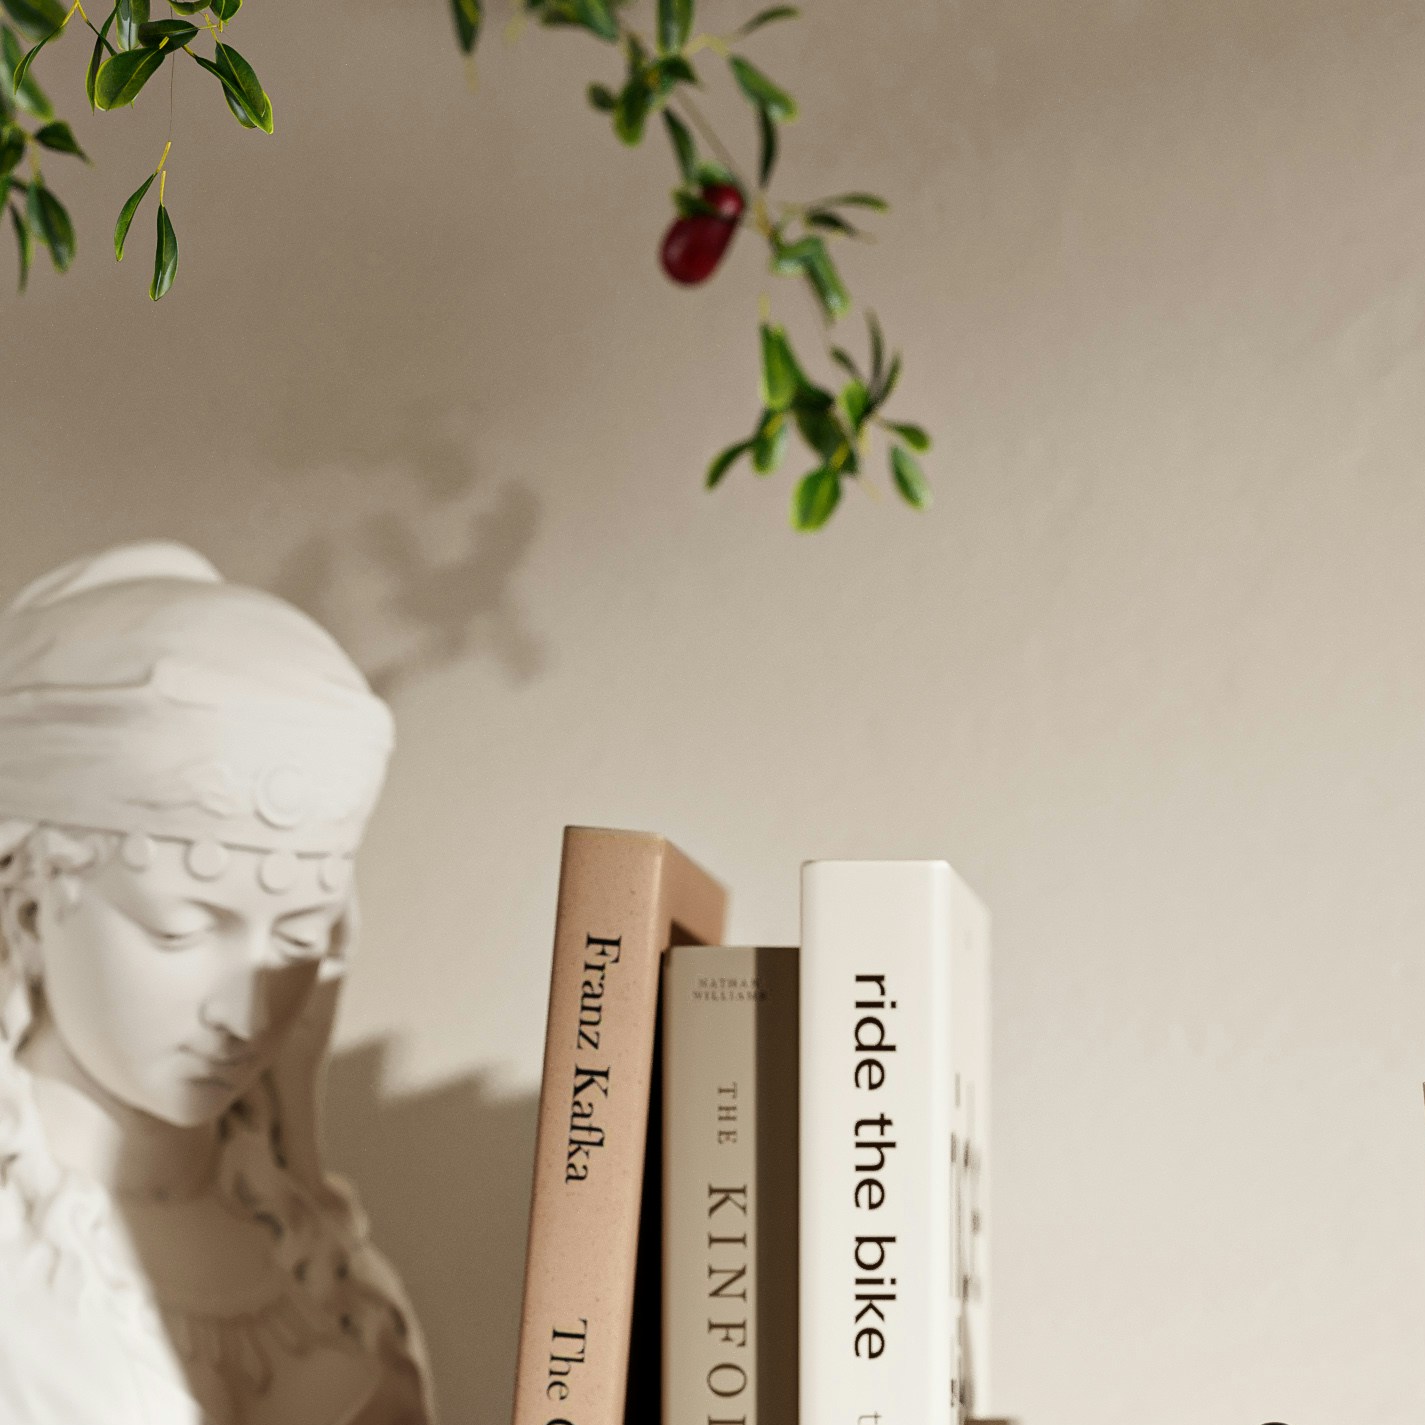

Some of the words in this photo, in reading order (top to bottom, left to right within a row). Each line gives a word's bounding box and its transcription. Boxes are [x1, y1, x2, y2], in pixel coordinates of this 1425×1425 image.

[577, 934, 621, 1049] Franz
[855, 975, 896, 1090] ride
[566, 1065, 610, 1183] Kafka
[717, 1082, 737, 1144] THE
[854, 1113, 896, 1210] the
[855, 1236, 896, 1359] bike
[547, 1319, 587, 1400] The
